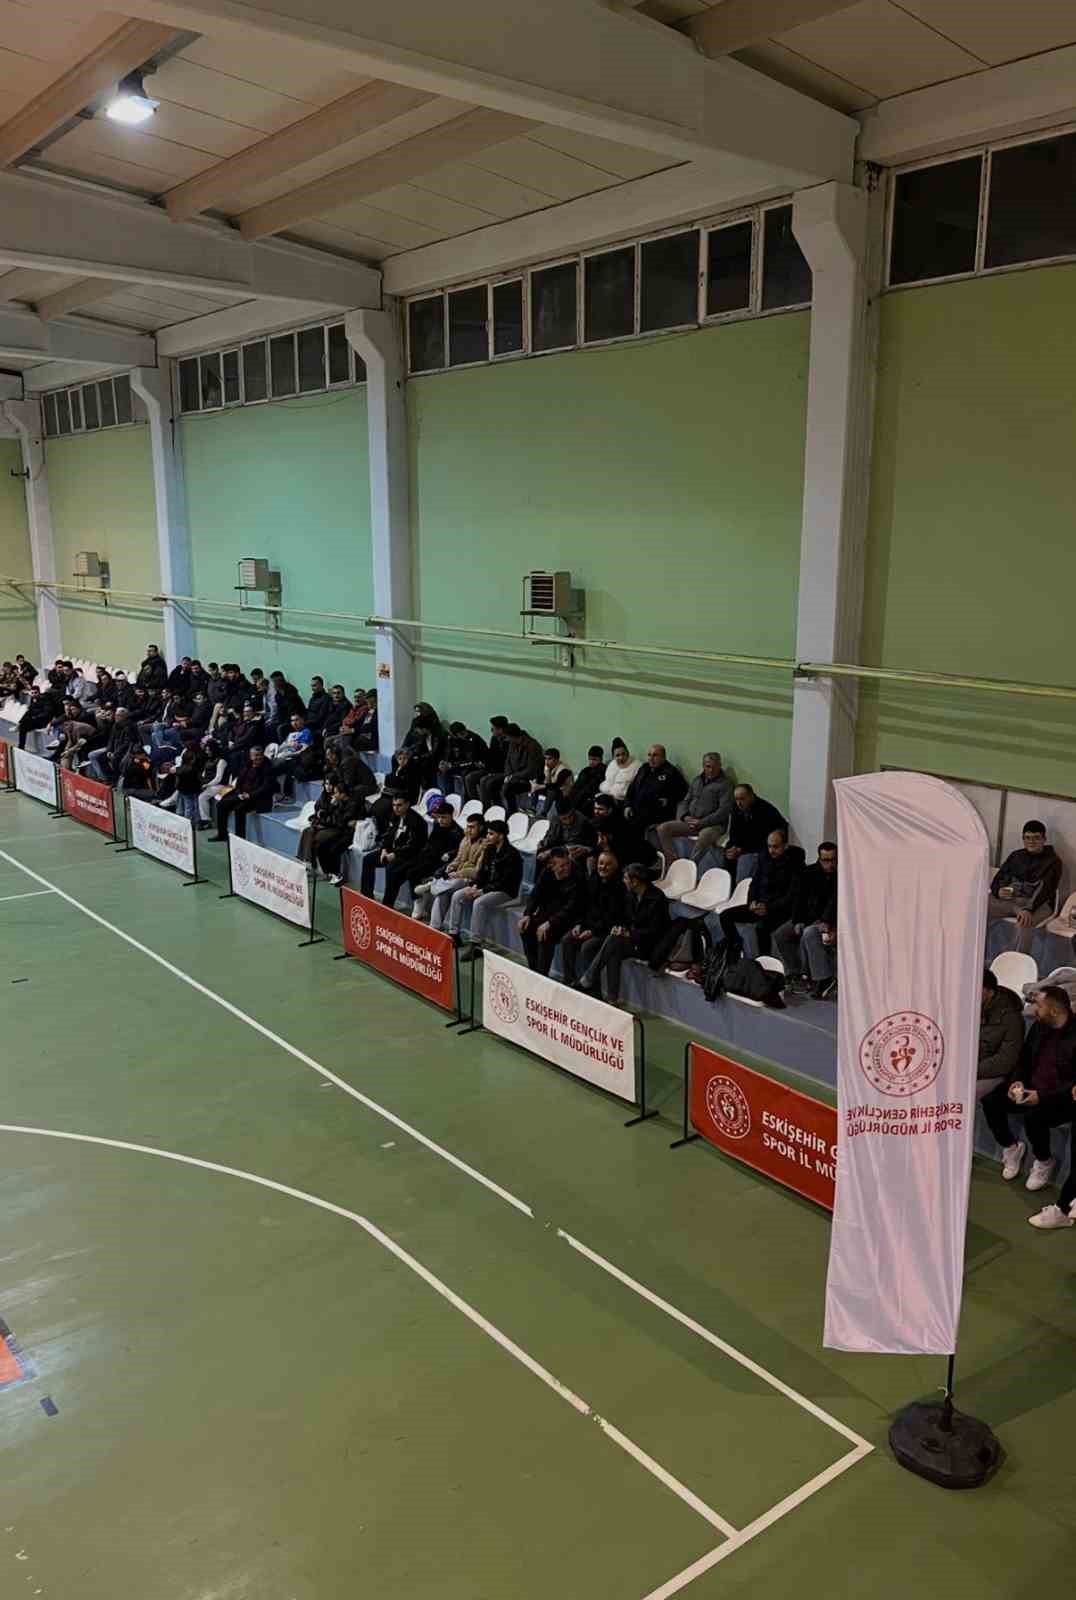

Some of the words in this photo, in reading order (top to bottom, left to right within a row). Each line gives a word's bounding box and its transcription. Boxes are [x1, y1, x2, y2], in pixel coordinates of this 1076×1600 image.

[375, 940, 393, 958] SPOR
[526, 998, 568, 1026] ESKİŞEHİR
[570, 1018, 609, 1045] GENÇLİK
[610, 1036, 624, 1052] VE
[526, 1015, 548, 1036] SPOR
[550, 1024, 559, 1041] İL
[560, 1031, 624, 1070] MÜDÜRLÜĞÜ
[762, 1111, 826, 1154] ESKİŞEHİR
[762, 1133, 796, 1161] SPOR
[799, 1147, 812, 1169] İL
